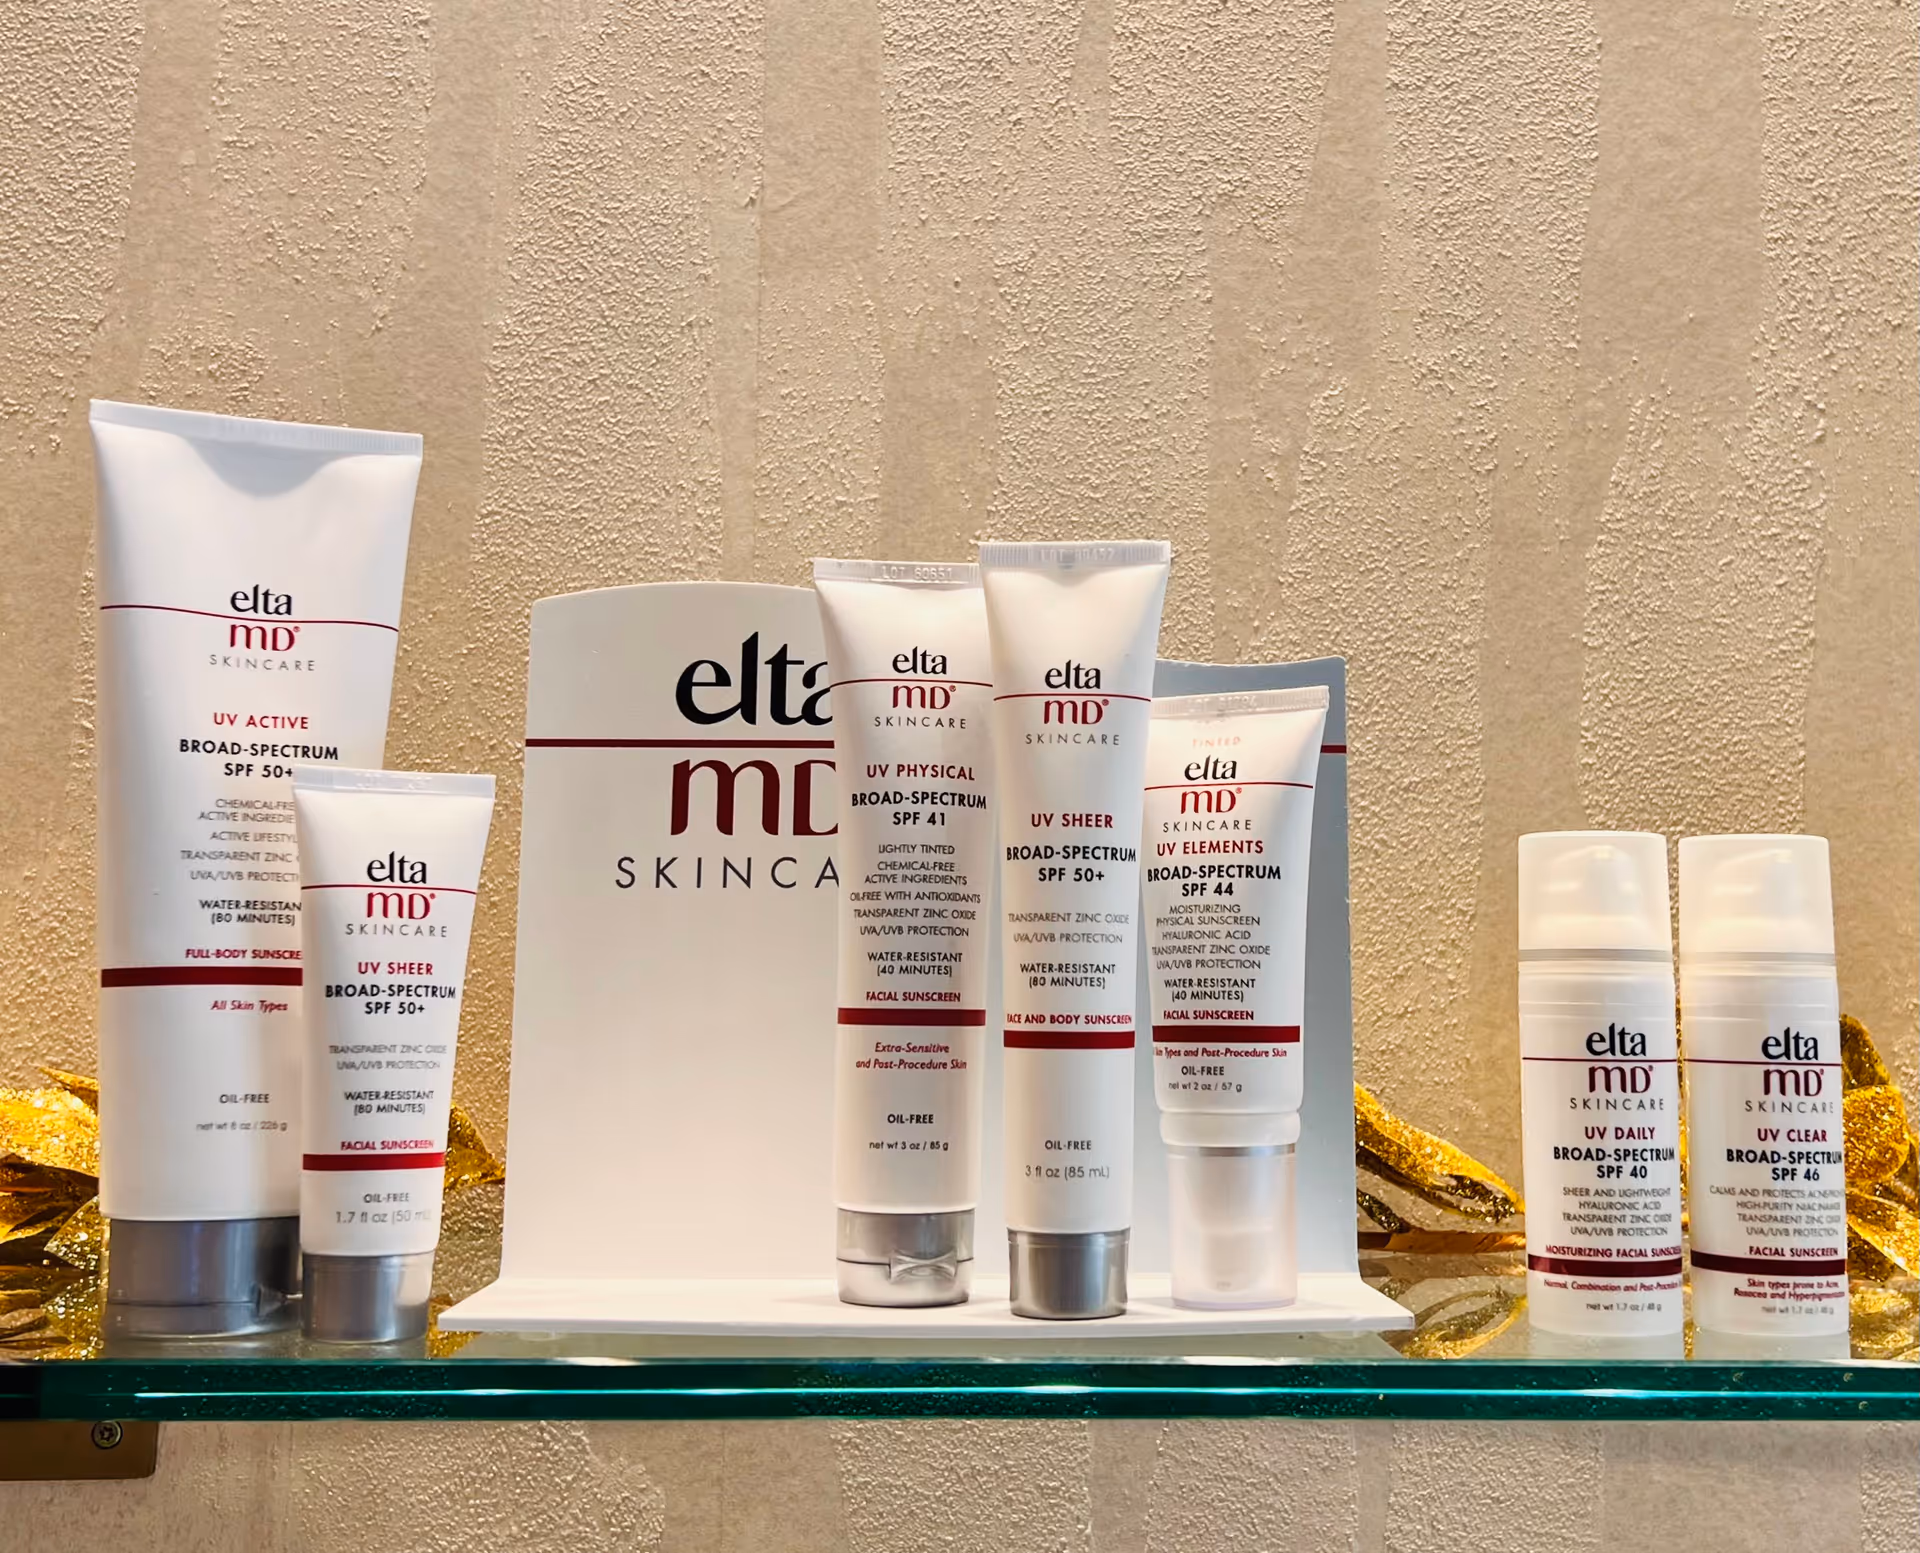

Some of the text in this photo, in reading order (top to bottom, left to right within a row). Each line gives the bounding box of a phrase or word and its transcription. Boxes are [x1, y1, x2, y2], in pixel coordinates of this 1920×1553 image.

[882, 565, 904, 579] LOT
[230, 584, 293, 615] elta
[210, 654, 315, 671] SKINCARE
[892, 646, 947, 675] elta
[676, 631, 833, 726] elta
[1045, 660, 1101, 690] elta
[214, 712, 309, 729] UV ACTIVE
[874, 716, 966, 729] SKINCARE
[1026, 732, 1120, 746] SKINCARE
[1192, 736, 1240, 748] TINTED
[180, 740, 338, 760] BROAD-SPECTRUM
[224, 763, 293, 778] SPF 50+
[867, 764, 975, 780] UV PHYSICAL
[1184, 755, 1237, 780] elta
[852, 792, 986, 809] BROAD-SPECTRUM
[893, 812, 945, 826] SPF 41
[1032, 814, 1113, 828] UV SHEER
[1163, 820, 1252, 832] SKINCARE
[879, 844, 954, 854] LIGHTLY TINTED
[1006, 846, 1136, 862] BROAD-SPECTRUM
[1158, 840, 1264, 856] UV ELEMENTS
[367, 851, 426, 884] elta
[616, 856, 839, 888] SKINCA
[878, 862, 955, 872] CHEMICAL-FREE
[1038, 868, 1104, 882] SPF 50+
[1148, 865, 1281, 882] BROAD-SPECTRUM
[865, 874, 967, 886] ACTIVE INGREDIENTS
[1182, 883, 1234, 896] SPF 44
[850, 892, 981, 904] OIL-FREE WITH ANTIOXIDANTS
[199, 900, 302, 911] WATER-RESISTAN
[1169, 904, 1240, 914] MOISTURIZING
[211, 914, 295, 926] (80 MINUTES)
[854, 908, 976, 920] TRANSPARENT ZINC OXIDE
[1156, 916, 1260, 926] PHYSICAL SUNSCREEN
[346, 924, 447, 937] SKINCARE
[860, 926, 969, 936] UVA/UVB PROTECTION
[1162, 930, 1250, 940] HYALURONIC ACID
[1060, 933, 1123, 944] PROTECTION
[185, 949, 302, 960] FULL-BODY SUNSCRE
[1152, 945, 1270, 956] TRANSPARENT ZINC OXIDE
[868, 952, 963, 962] WATER-RESISTANT
[358, 962, 433, 975] UV SHEER
[1020, 964, 1116, 974] WATER-RESISTANT
[1156, 960, 1260, 970] UVA/UVB PROTECTION
[877, 966, 952, 977] (40 MINUTES)
[1029, 977, 1106, 989] (80 MINUTES)
[1164, 979, 1256, 988] WATER-RESISTANT
[325, 984, 456, 998] BROAD-SPECTRUM
[866, 992, 961, 1002] FACIAL SUNSCREEN
[1172, 991, 1244, 1002] (40 MINUTES)
[210, 1000, 288, 1013] All Skin Types
[365, 1002, 424, 1014] SPF 50+
[1024, 1014, 1046, 1024] AND
[1050, 1015, 1080, 1024] BODY
[1084, 1014, 1132, 1024] SUNSCREEN
[1164, 1011, 1254, 1020] FACIAL SUNSCREEN
[1586, 1023, 1646, 1056] elta
[1762, 1027, 1818, 1060] elta
[875, 1042, 950, 1053] Extra-Sensitive
[1184, 1048, 1198, 1057] and
[1202, 1048, 1269, 1057] Post-Procedure
[1272, 1048, 1286, 1056] Skin
[856, 1059, 967, 1070] and Post-Procedure Skin
[1182, 1066, 1224, 1075] OIL-FREE
[219, 1094, 269, 1103] OIL-FREE
[344, 1091, 434, 1100] WATER-RESISTANT
[354, 1104, 426, 1116] (80 MINUTES)
[1570, 1098, 1663, 1110] SKINCARE
[1745, 1101, 1833, 1113] SKINCARE
[888, 1114, 934, 1124] OIL-FREE
[1585, 1126, 1655, 1140] UV DAILY
[1758, 1128, 1827, 1142] UV CLEAR
[340, 1141, 376, 1150] FACIAL
[1045, 1140, 1092, 1150] OIL-FREE
[1554, 1147, 1674, 1161] BROAD-SPECTRUM
[1025, 1165, 1032, 1176] 3
[1035, 1166, 1042, 1177] fl
[1046, 1168, 1060, 1178] oz
[1064, 1166, 1084, 1180] (85
[1597, 1166, 1647, 1179] SPF 40
[1772, 1168, 1820, 1181] SPF 46
[1563, 1187, 1590, 1196] SHEER
[1593, 1188, 1615, 1196] AND
[364, 1193, 409, 1203] OIL-FREE
[336, 1212, 356, 1222] 1.7
[372, 1214, 388, 1222] oz
[1617, 1228, 1667, 1236] PROTECTION
[1546, 1245, 1612, 1258] MOISTURIZING
[1616, 1249, 1648, 1258] FACIAL
[1749, 1246, 1838, 1257] FACIAL SUNSCREEN
